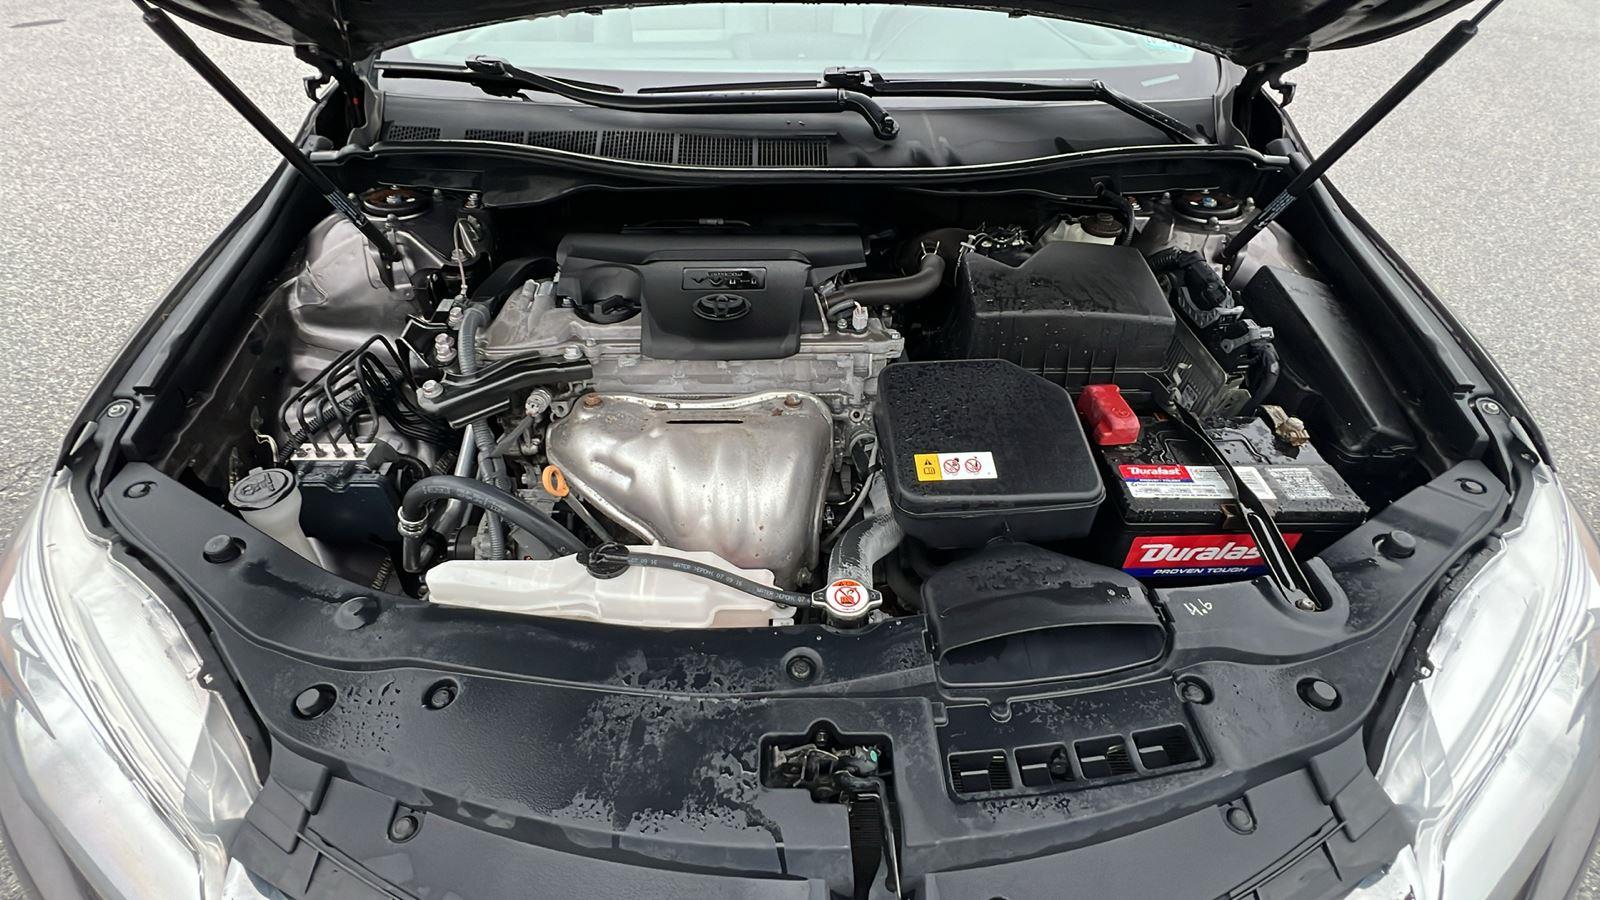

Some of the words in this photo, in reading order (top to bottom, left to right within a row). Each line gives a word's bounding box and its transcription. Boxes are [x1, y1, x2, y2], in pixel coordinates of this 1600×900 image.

[1127, 467, 1181, 475] Duralast
[1139, 542, 1262, 562] Duralas
[1207, 566, 1249, 574] TOUGH
[1183, 598, 1213, 616] 4.6
